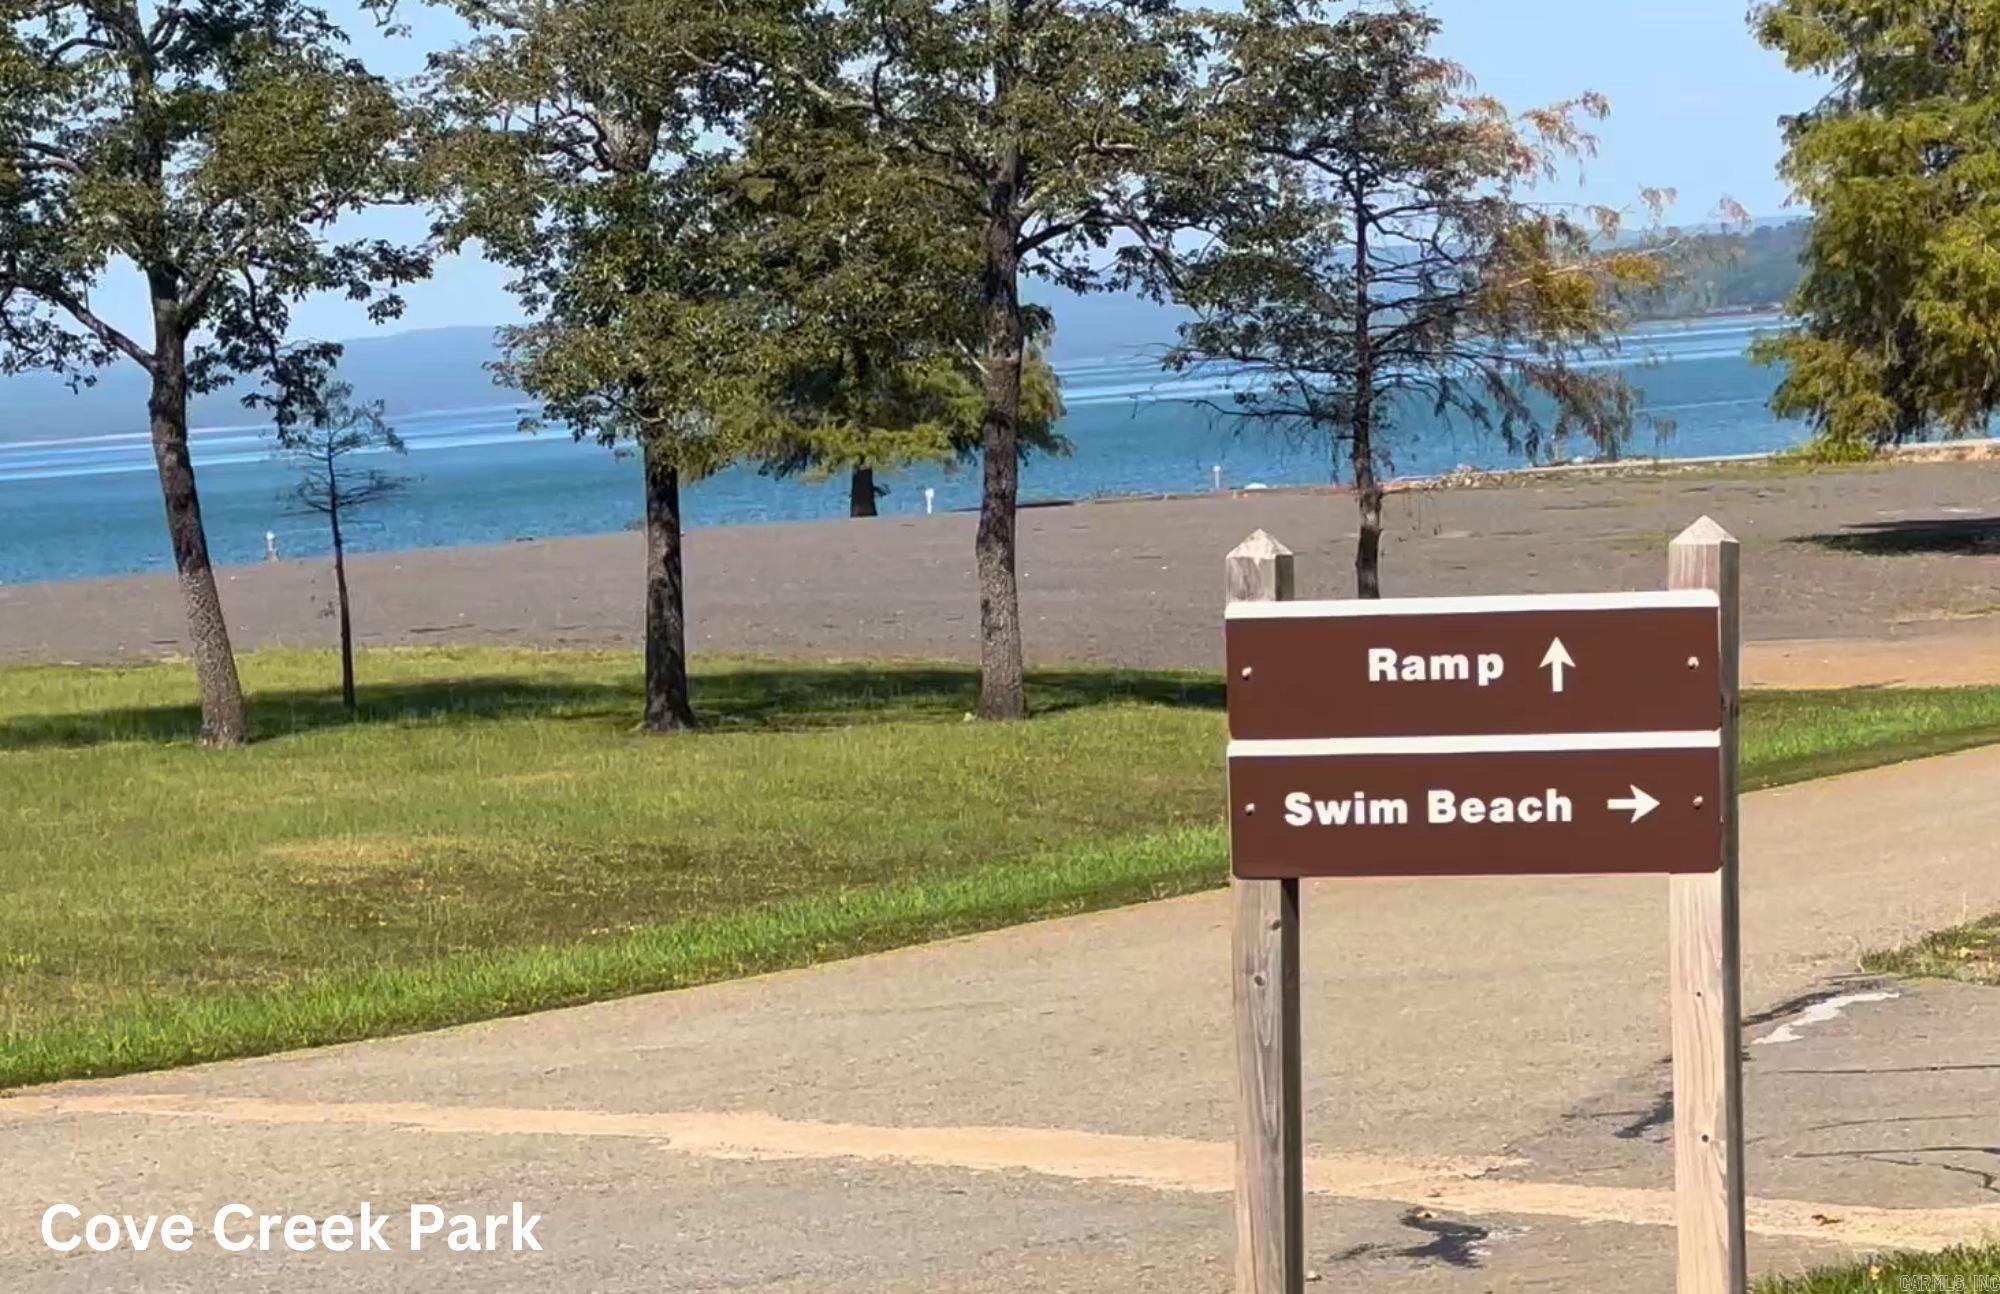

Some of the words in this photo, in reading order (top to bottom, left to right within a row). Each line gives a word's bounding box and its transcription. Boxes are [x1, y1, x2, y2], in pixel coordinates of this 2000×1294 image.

[1367, 647, 1505, 687] Ramp
[1284, 790, 1409, 826] Swim
[1427, 788, 1573, 823] Beach
